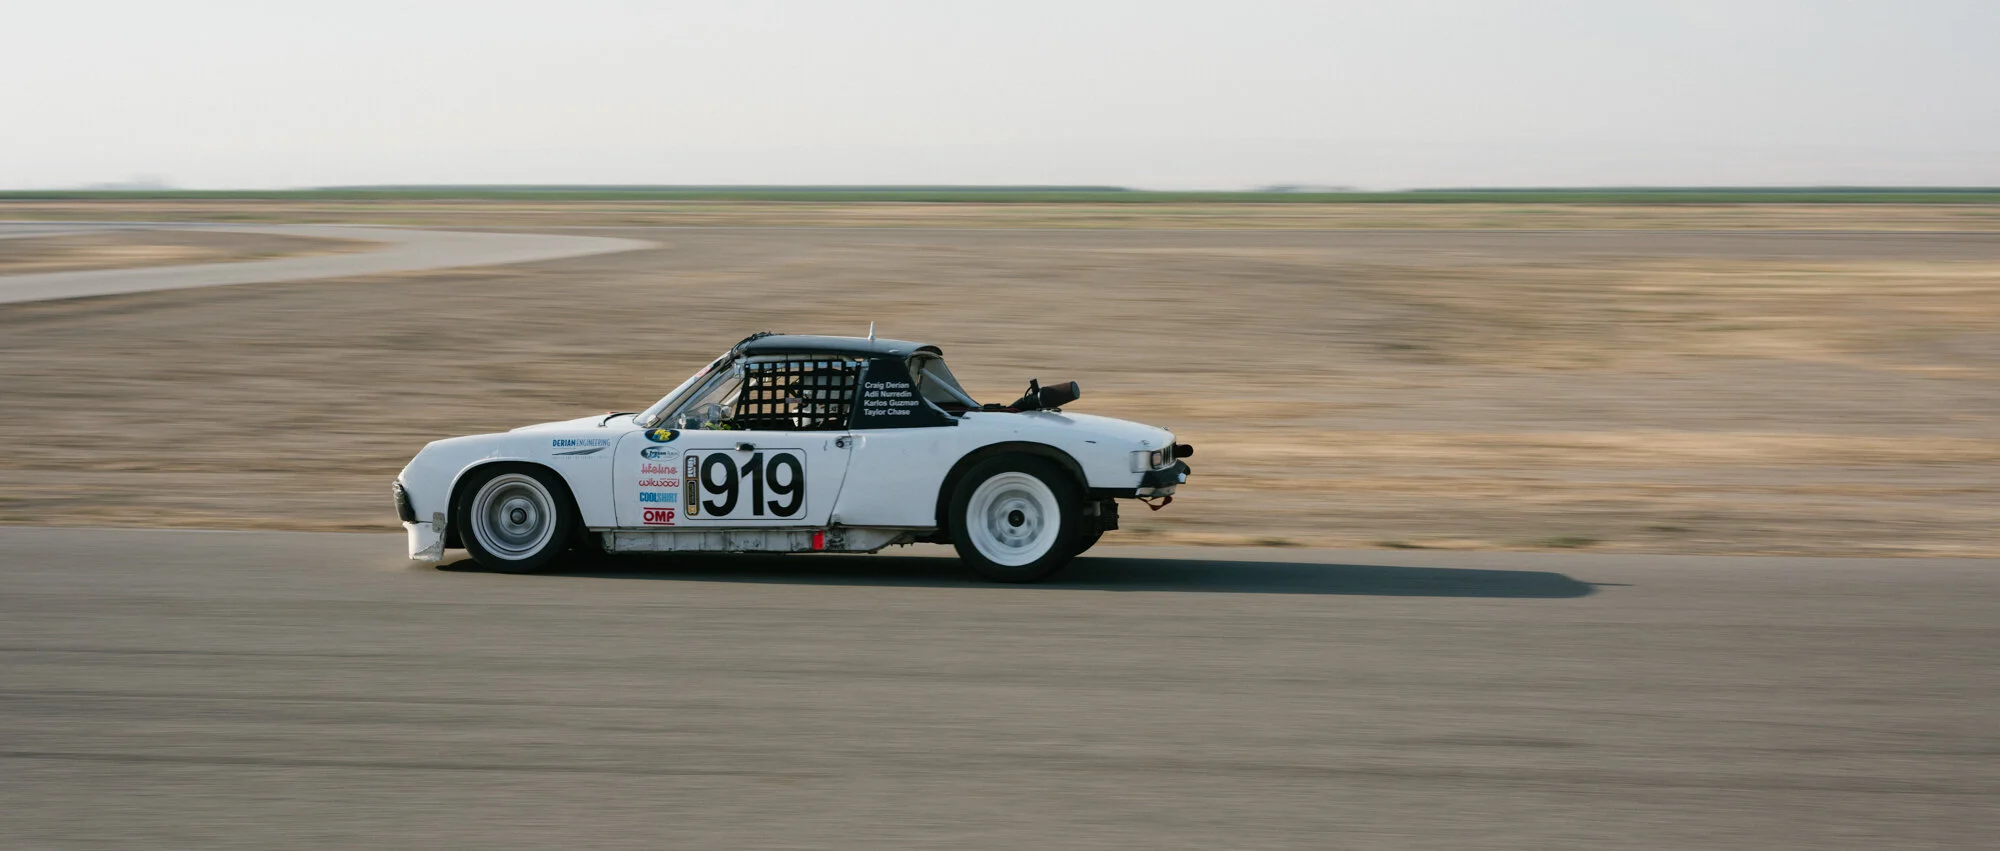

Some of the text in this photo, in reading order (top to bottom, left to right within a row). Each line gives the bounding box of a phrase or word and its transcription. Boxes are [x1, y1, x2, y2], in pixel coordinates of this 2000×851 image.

[864, 381, 909, 390] Craig Derian
[864, 408, 886, 416] Taylor
[552, 438, 611, 447] DERIAN ENGINEERING
[641, 463, 678, 475] lifeline
[638, 478, 680, 487] wilwood
[701, 452, 804, 517] 919
[643, 510, 675, 522] OMP
